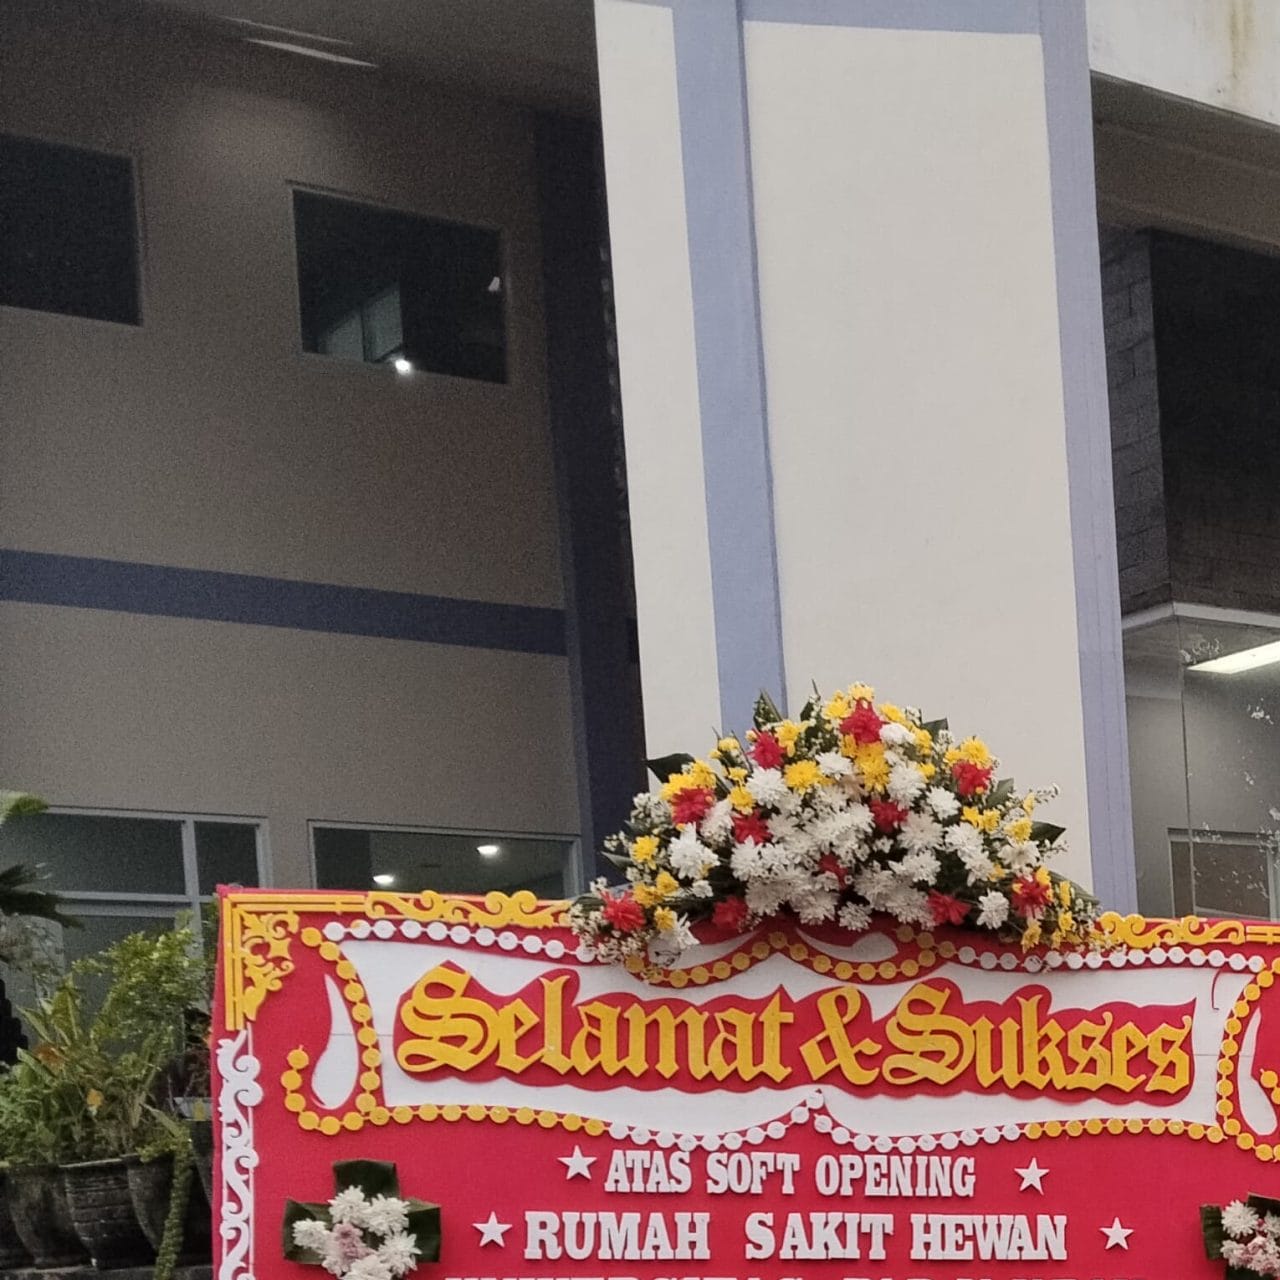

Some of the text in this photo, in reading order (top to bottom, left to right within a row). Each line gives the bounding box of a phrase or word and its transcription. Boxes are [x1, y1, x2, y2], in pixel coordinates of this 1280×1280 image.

[396, 959, 1194, 1096] Selamat & Sukses
[604, 1150, 976, 1197] ATAS SOFT OPENING
[523, 1211, 1068, 1261] RUMAH SAKIT HEWAN
